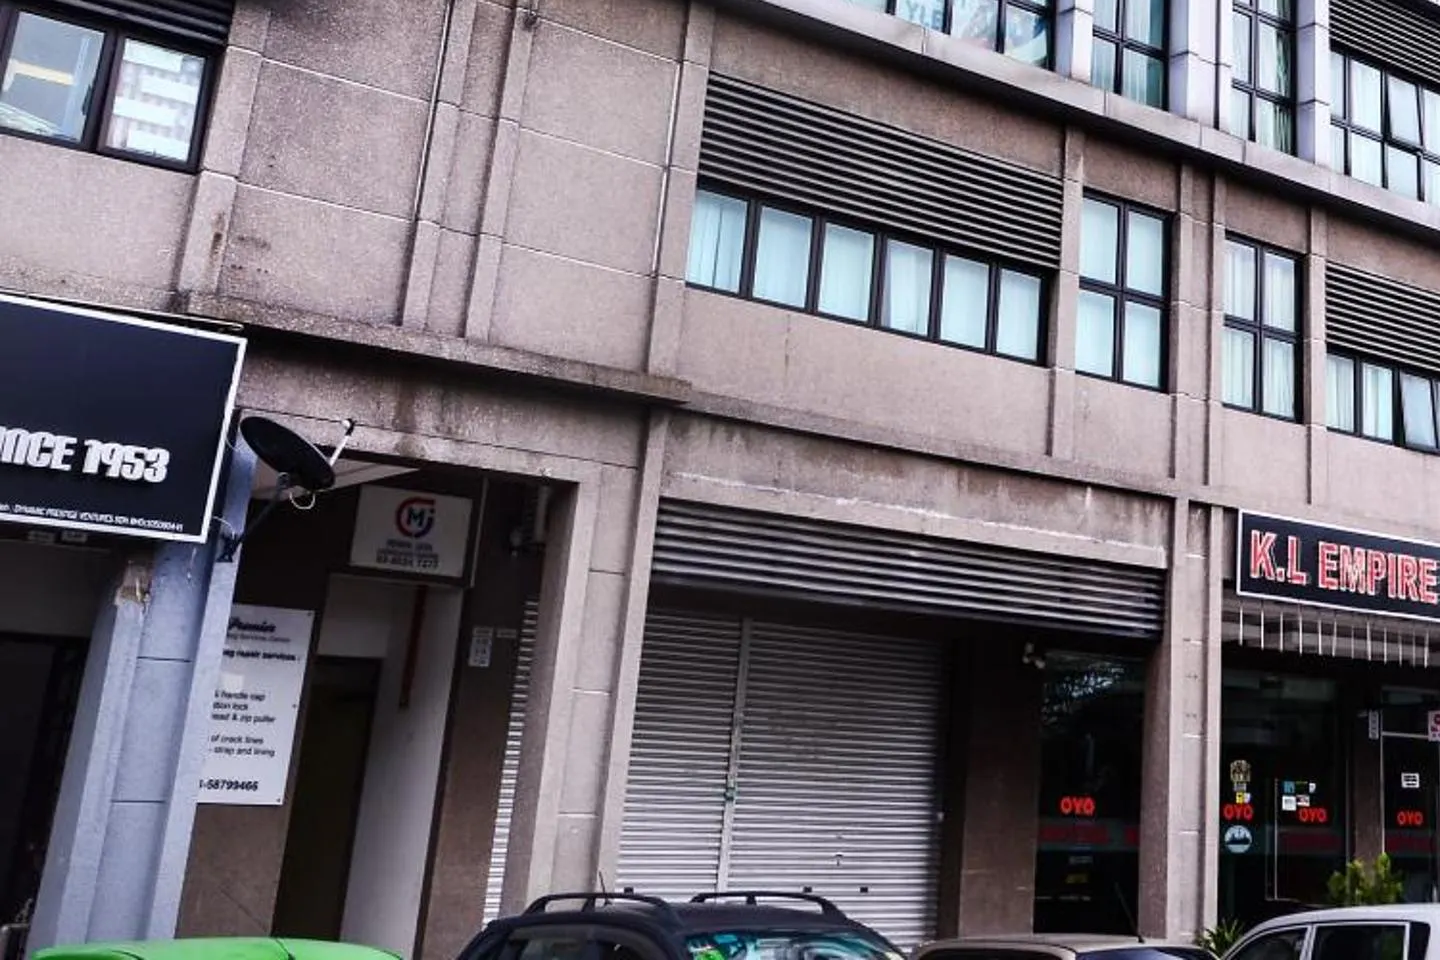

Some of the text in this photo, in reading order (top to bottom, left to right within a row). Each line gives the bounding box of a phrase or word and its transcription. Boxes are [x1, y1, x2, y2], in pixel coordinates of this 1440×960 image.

[82, 439, 170, 483] 1953
[1250, 529, 1309, 586] K.L
[1317, 541, 1440, 605] EMPIRE
[1060, 796, 1096, 816] OYO
[1224, 803, 1254, 820] OYO
[1299, 808, 1328, 823] OYO
[1397, 811, 1424, 826] OYO
